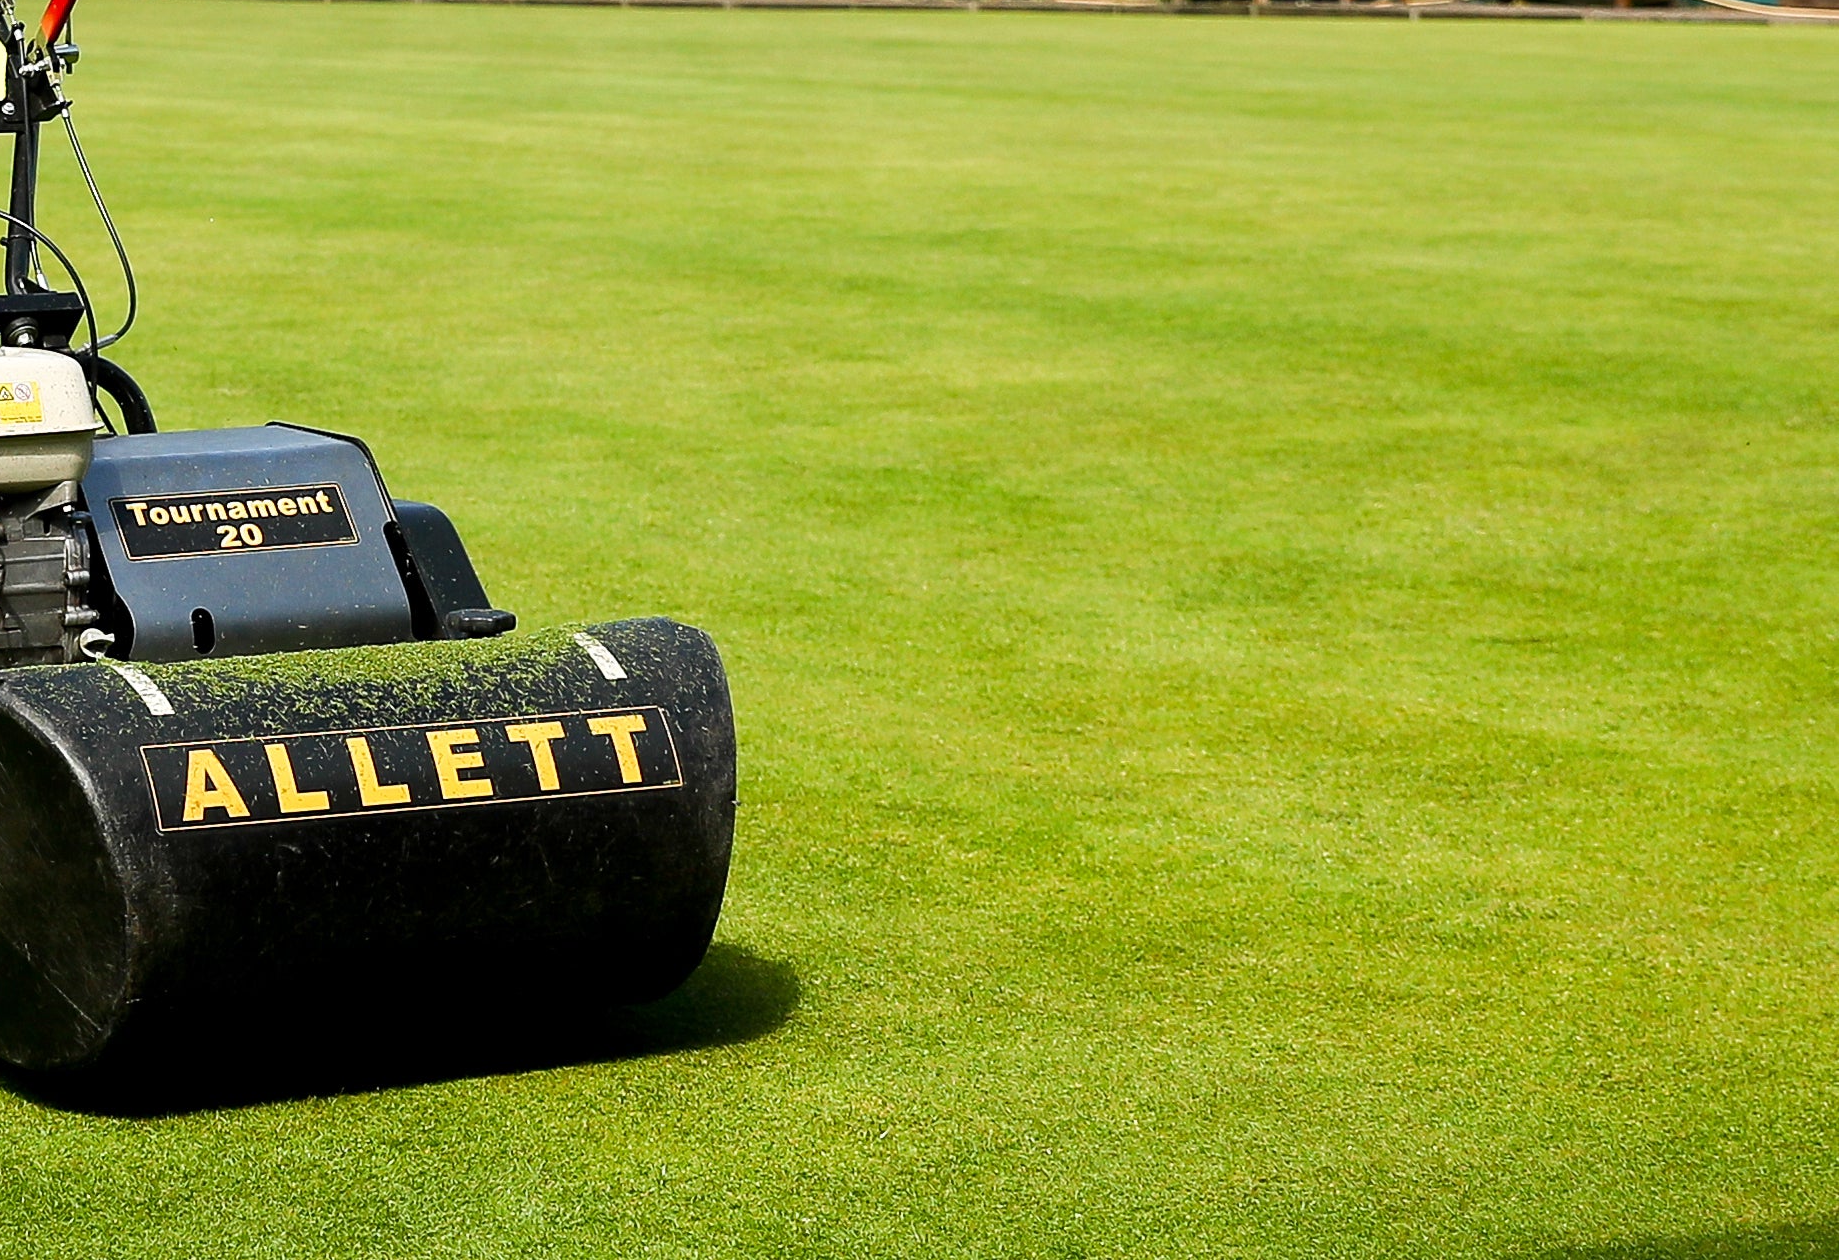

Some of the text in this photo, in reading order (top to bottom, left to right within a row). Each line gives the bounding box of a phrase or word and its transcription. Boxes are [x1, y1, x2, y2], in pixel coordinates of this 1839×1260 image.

[125, 490, 334, 527] Tournament
[216, 522, 264, 548] 20
[182, 714, 647, 821] ALLETT
